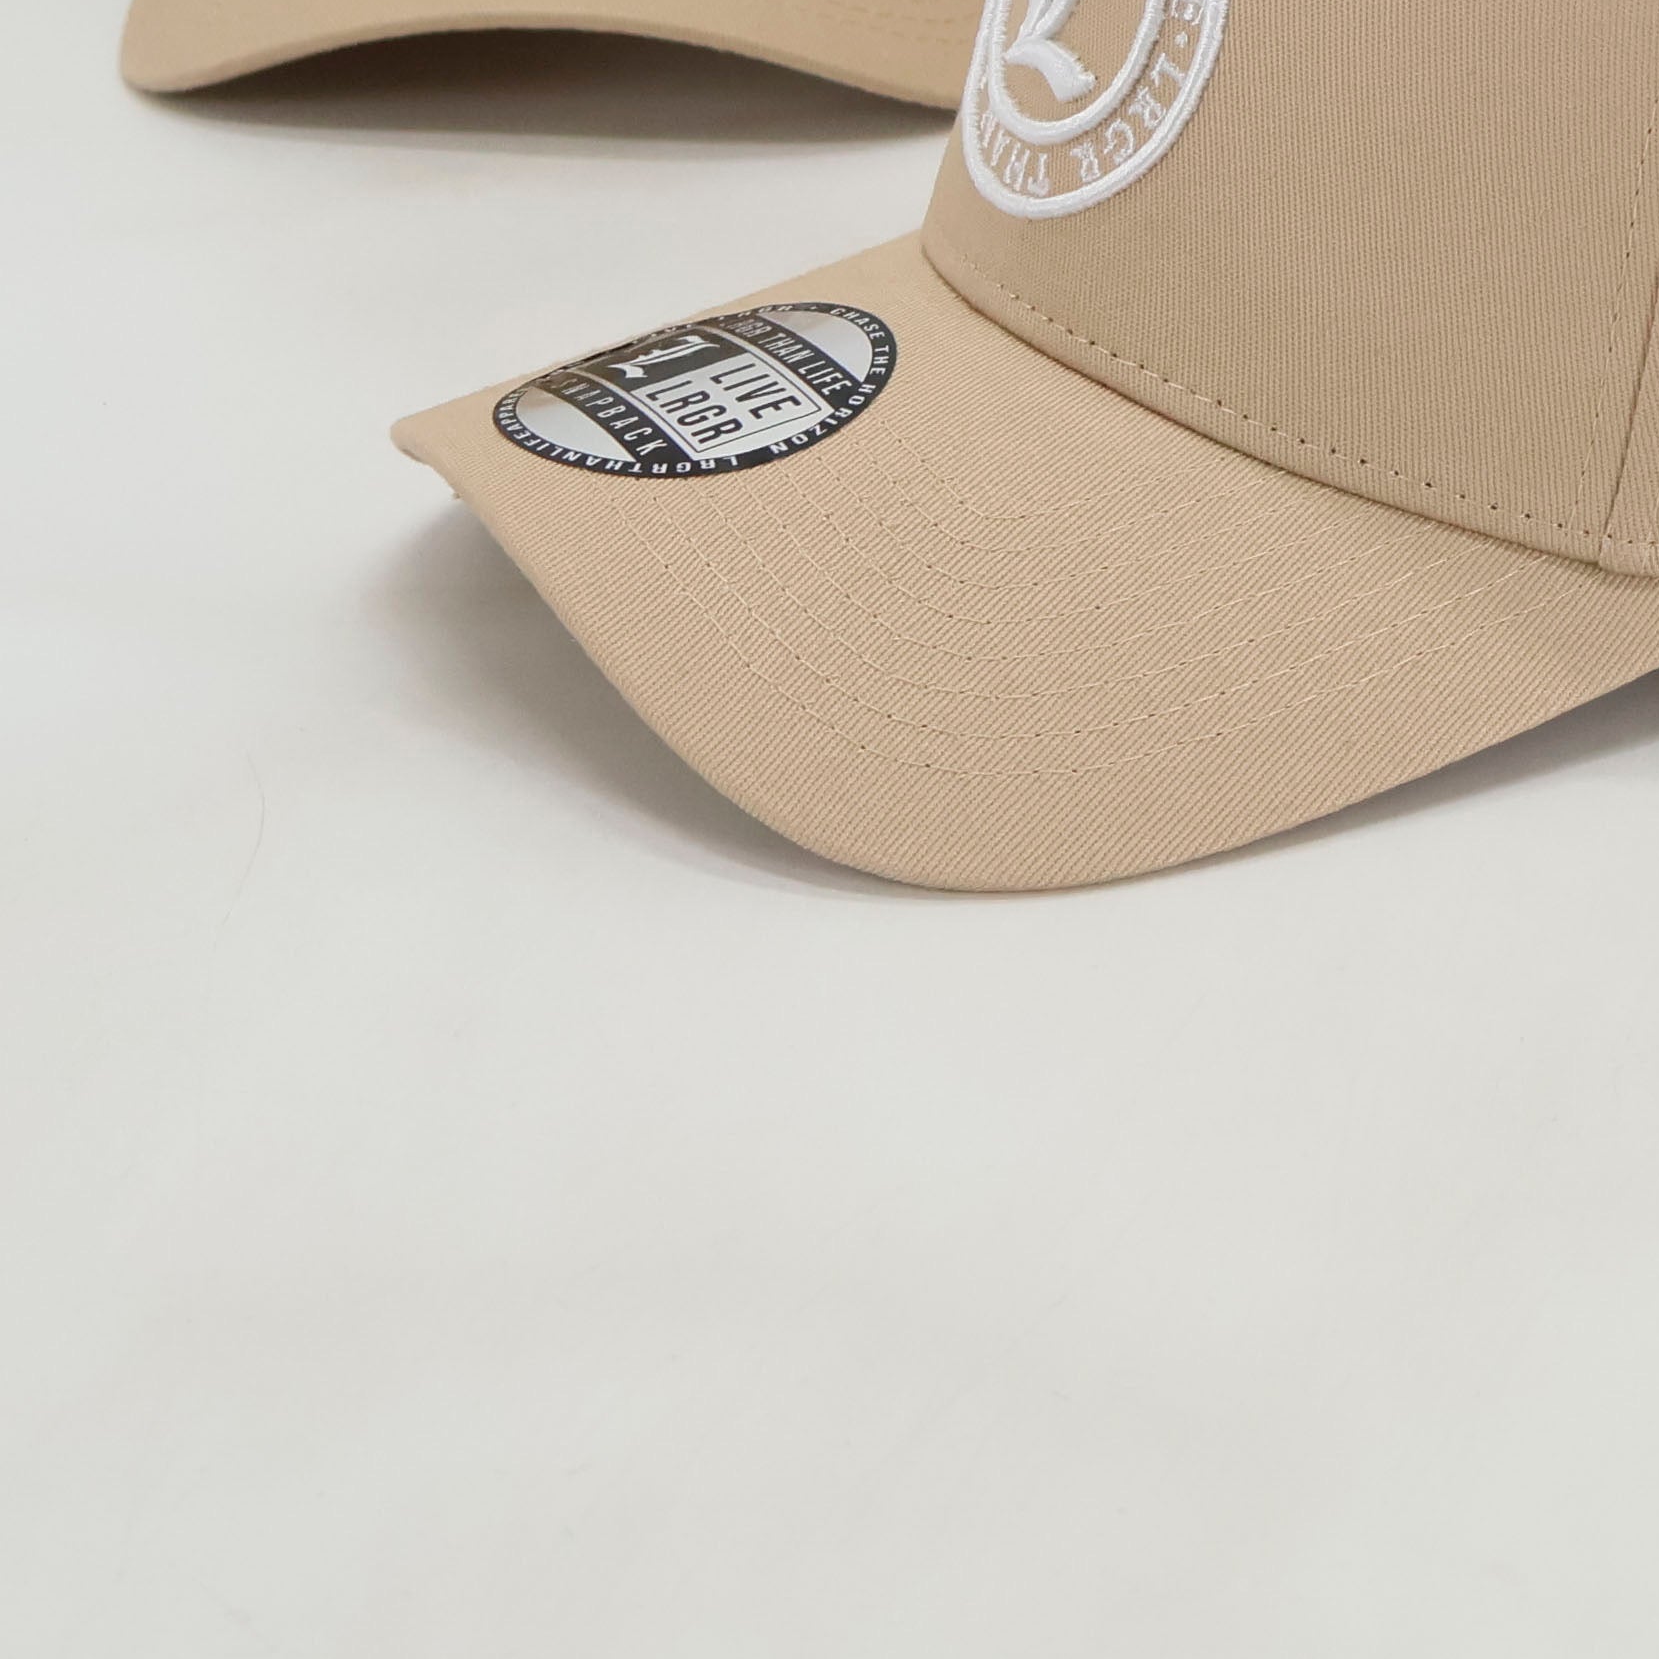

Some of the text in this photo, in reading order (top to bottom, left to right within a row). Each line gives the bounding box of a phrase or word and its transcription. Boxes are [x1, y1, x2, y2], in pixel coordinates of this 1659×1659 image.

[1069, 53, 1188, 184] LRGR
[830, 307, 886, 340] CHASE
[709, 363, 802, 420] LIVE
[758, 332, 815, 364] THAN
[798, 361, 853, 396] LIFE
[870, 345, 890, 376] THE
[645, 379, 744, 445] LRGR
[769, 383, 877, 454] HORIZON
